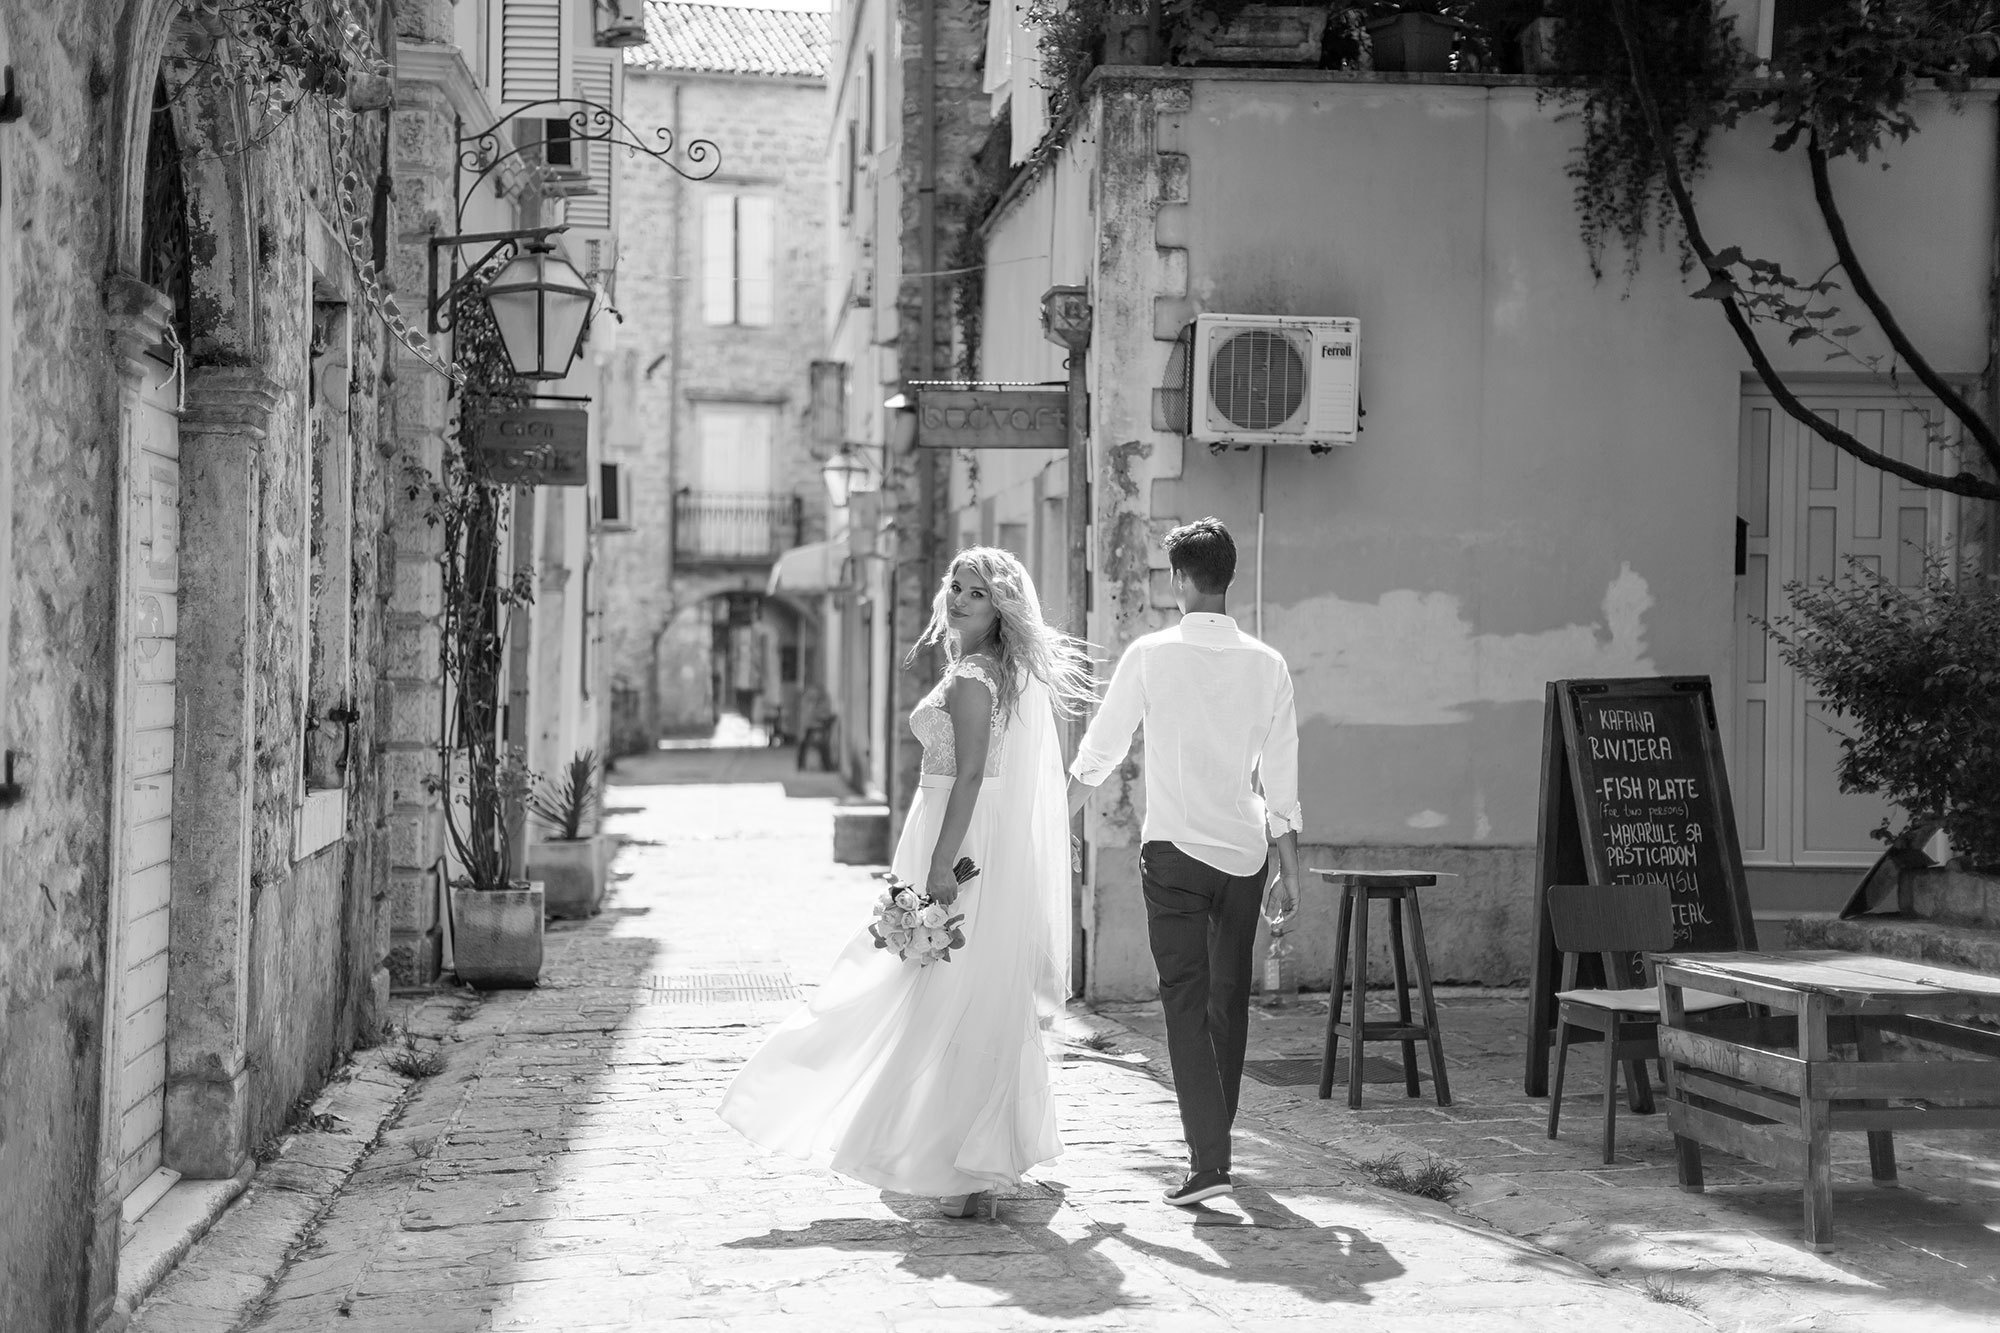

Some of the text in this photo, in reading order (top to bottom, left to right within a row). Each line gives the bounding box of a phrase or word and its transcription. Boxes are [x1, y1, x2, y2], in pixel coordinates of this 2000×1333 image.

[1599, 708, 1655, 733] KAFANA
[1588, 736, 1672, 762] RIVIJERA
[1595, 776, 1699, 800] -FISH PLATE
[1685, 822, 1703, 843] SA
